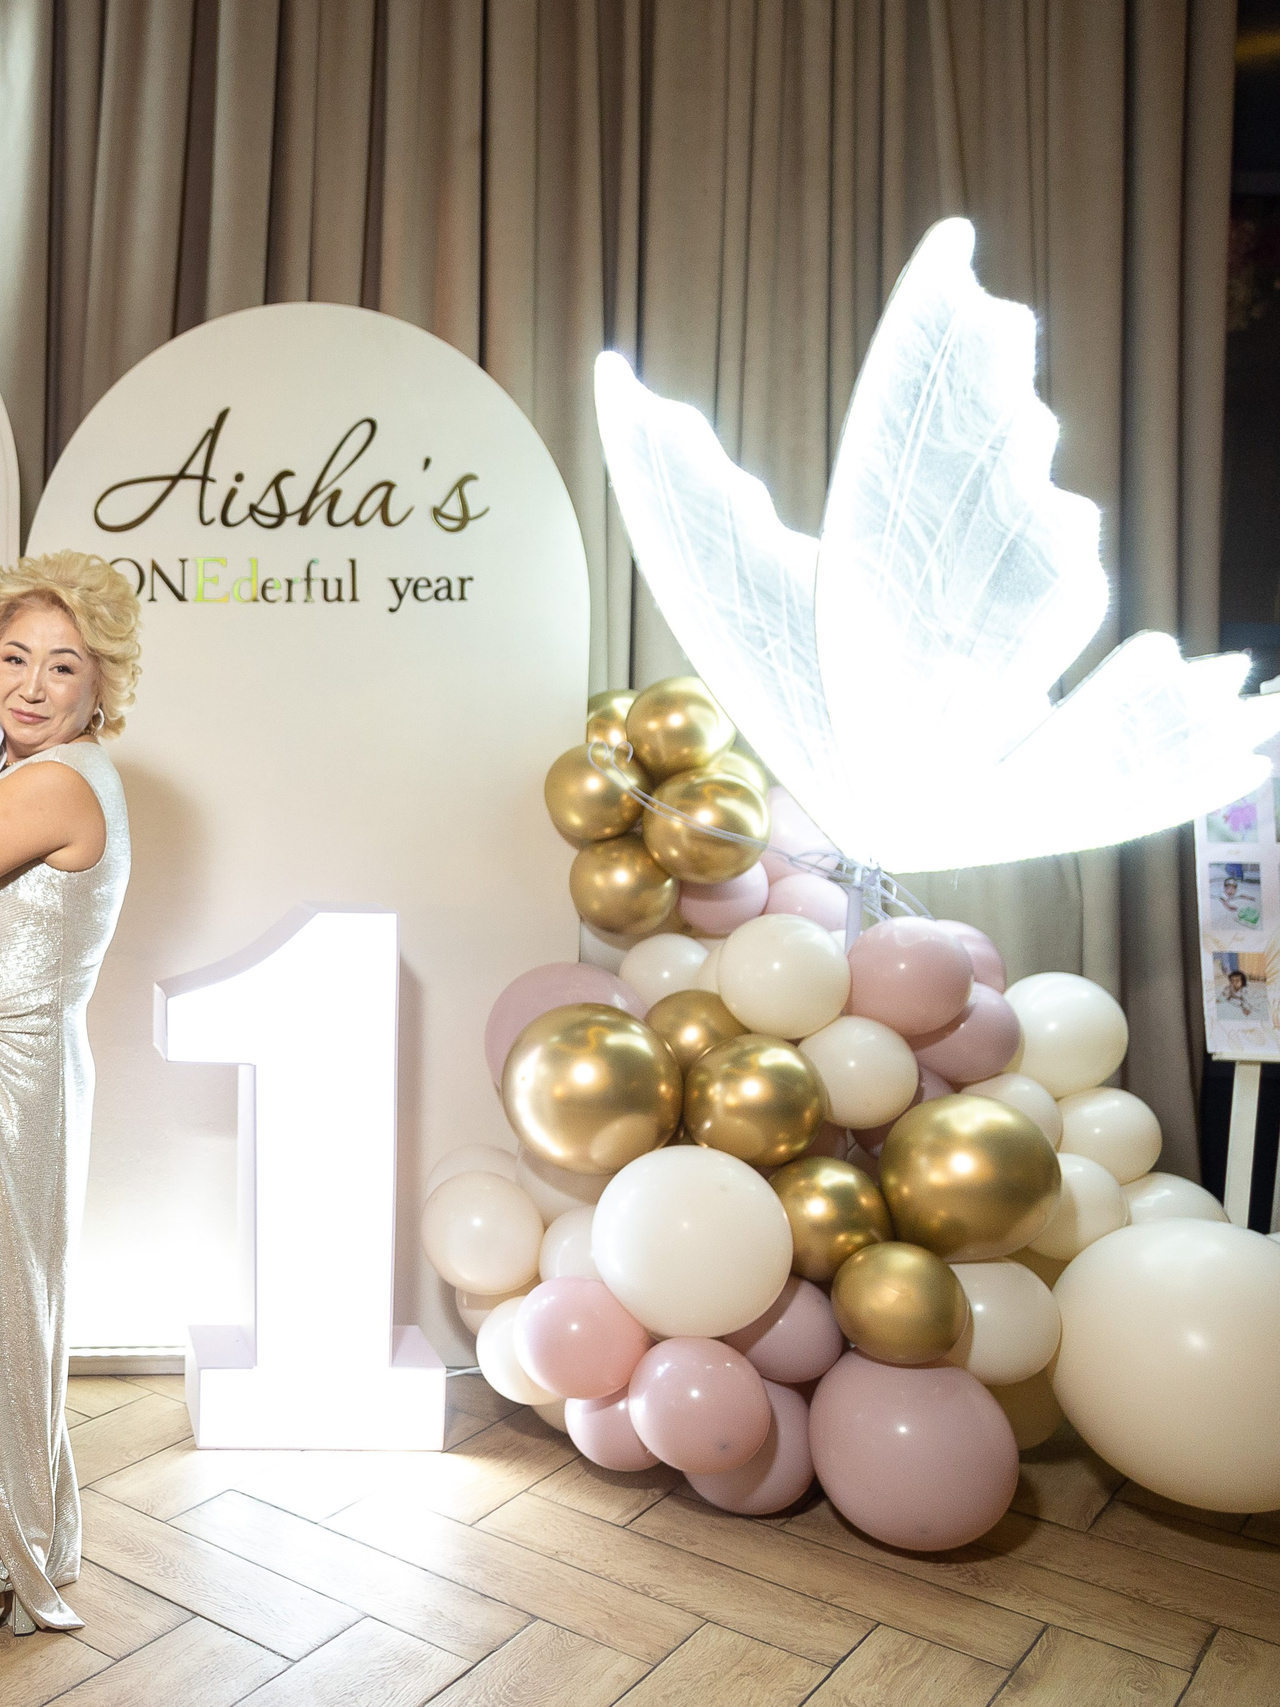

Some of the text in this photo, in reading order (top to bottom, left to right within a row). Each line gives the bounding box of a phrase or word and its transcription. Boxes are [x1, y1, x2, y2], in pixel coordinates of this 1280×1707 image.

[93, 406, 491, 533] Aisha's
[387, 576, 475, 613] year
[153, 903, 447, 1451] 1
